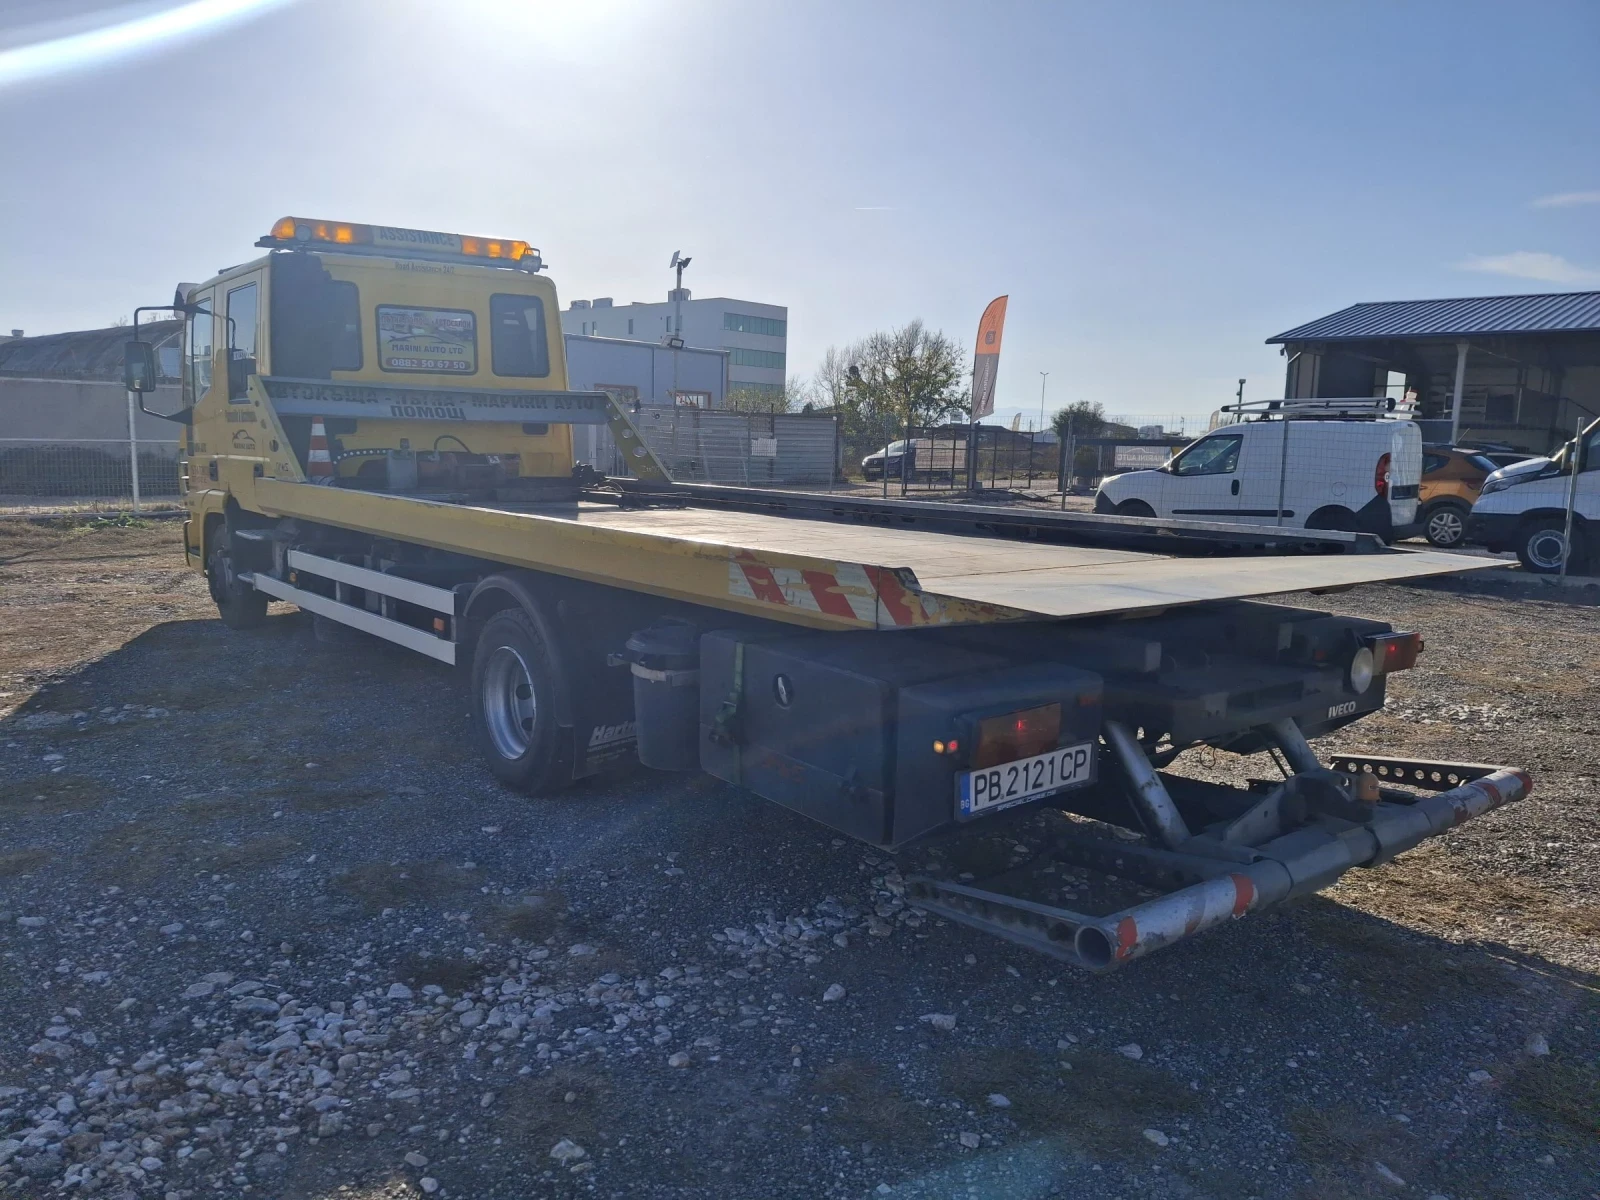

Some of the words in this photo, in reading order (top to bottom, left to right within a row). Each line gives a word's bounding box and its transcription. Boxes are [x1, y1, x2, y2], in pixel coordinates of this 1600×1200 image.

[379, 226, 455, 247] ASSISTANCE
[395, 261, 410, 271] Road
[411, 262, 442, 273] Assistance
[391, 343, 421, 353] MARINI
[424, 346, 447, 354] AUTO
[448, 347, 464, 355] LTD
[391, 358, 418, 367] 0882
[421, 359, 435, 368] 50
[437, 360, 449, 368] 67
[453, 361, 466, 369] 50
[390, 405, 467, 421] ПОМОЩ
[1328, 700, 1356, 718] IVECO
[960, 798, 970, 810] BG
